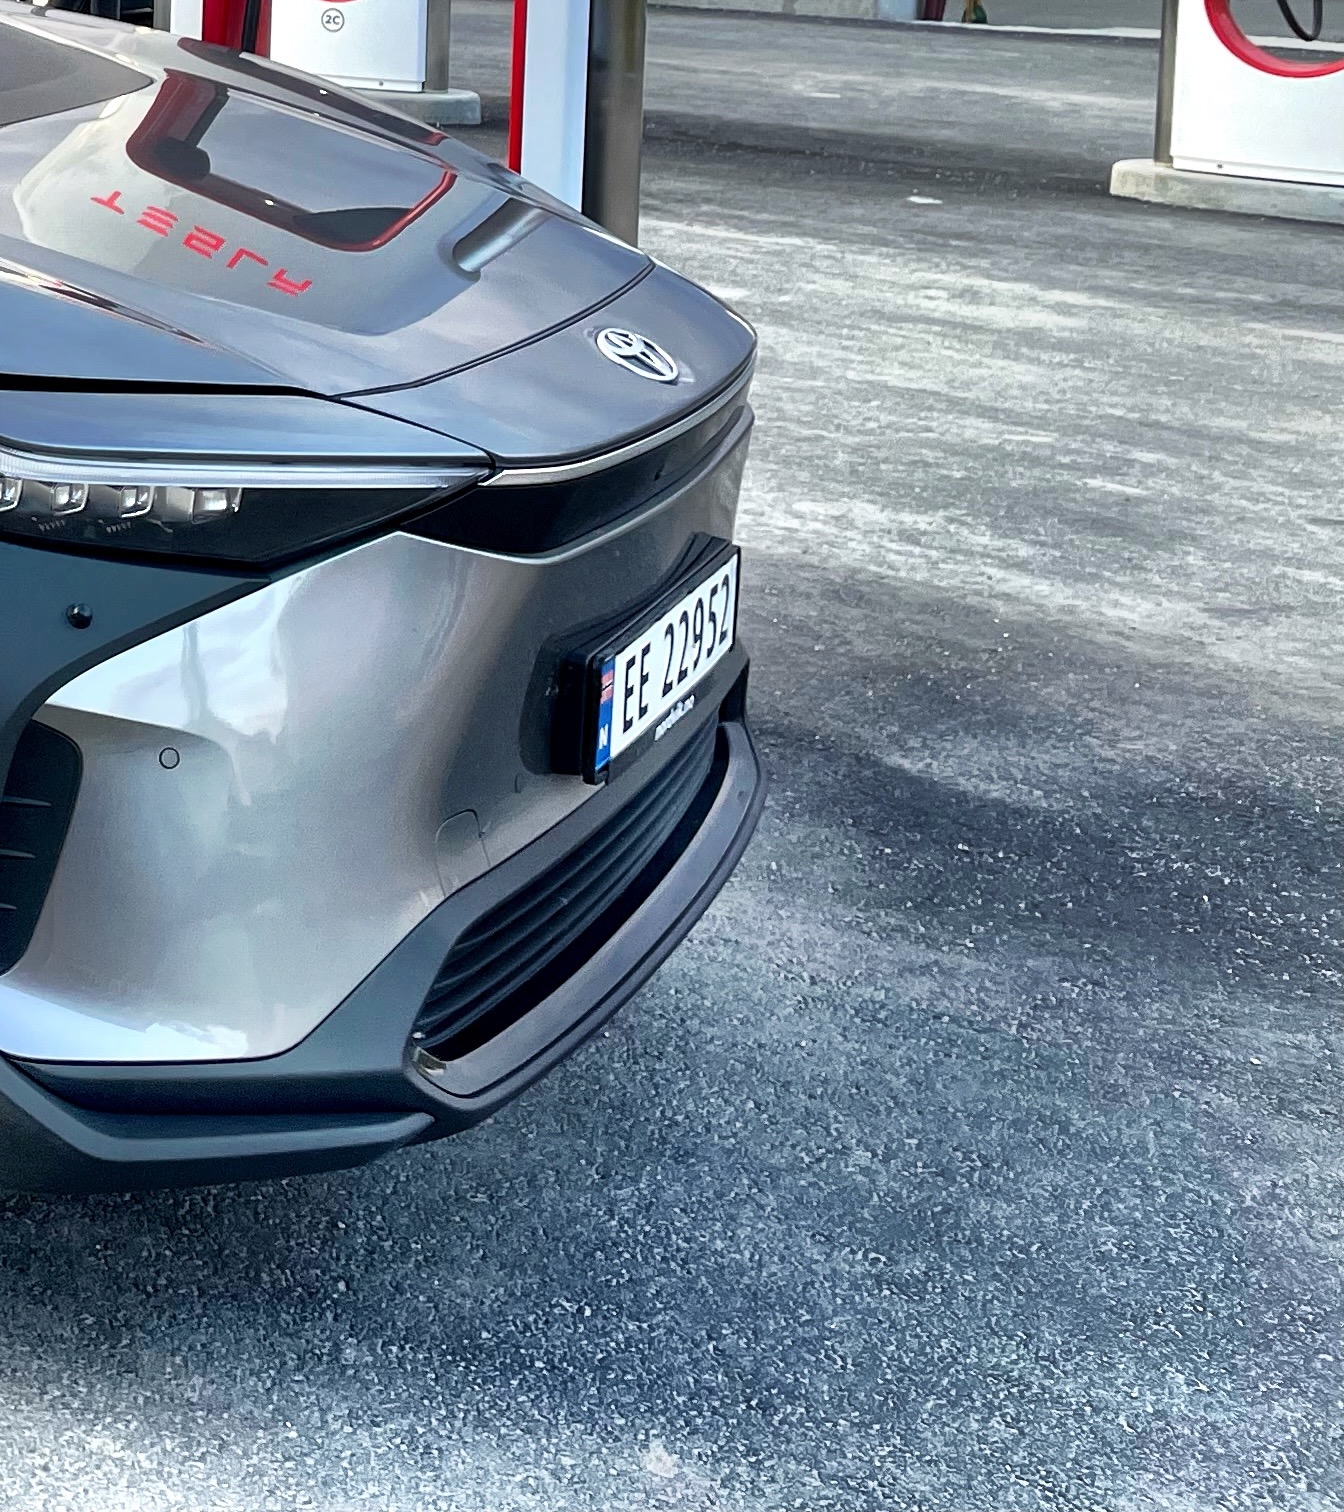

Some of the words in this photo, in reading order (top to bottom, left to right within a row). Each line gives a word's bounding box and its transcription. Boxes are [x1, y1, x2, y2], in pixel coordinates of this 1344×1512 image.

[324, 15, 341, 26] 2C
[623, 642, 651, 734] EE
[662, 574, 730, 698] 22952
[598, 723, 609, 749] N
